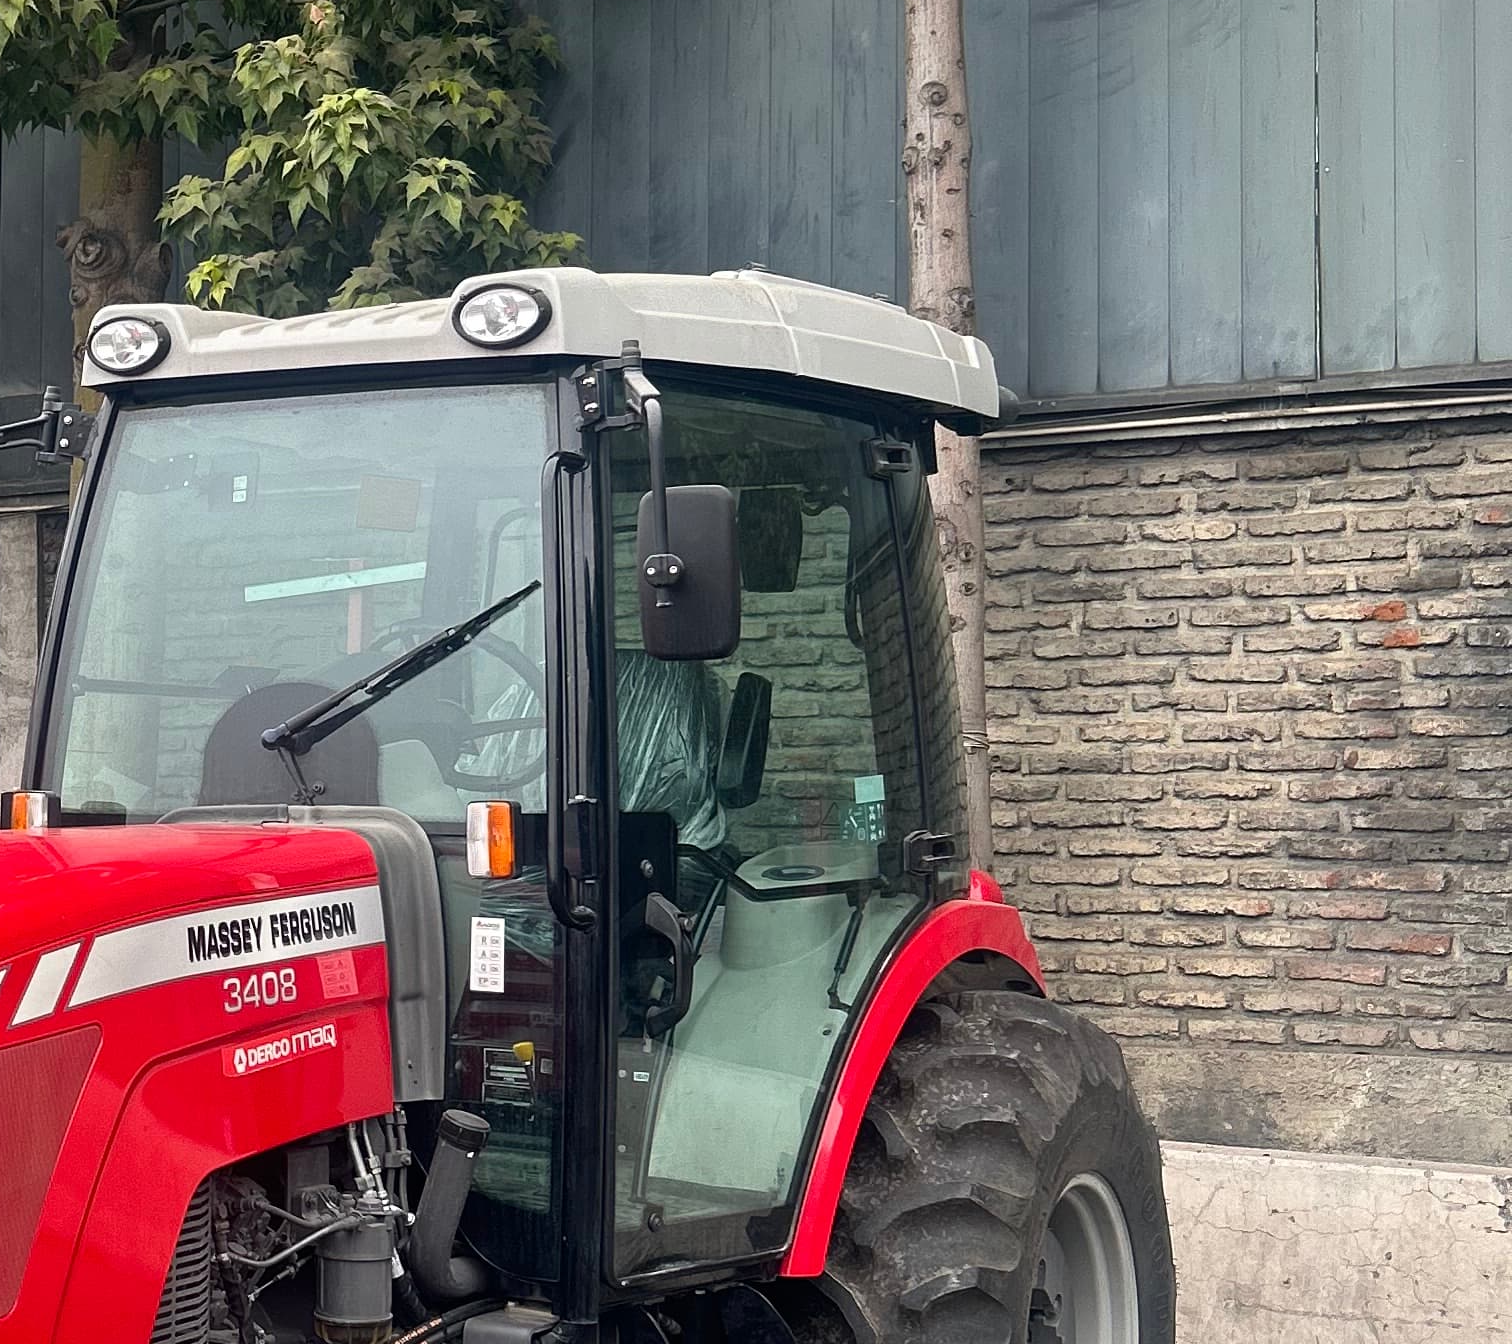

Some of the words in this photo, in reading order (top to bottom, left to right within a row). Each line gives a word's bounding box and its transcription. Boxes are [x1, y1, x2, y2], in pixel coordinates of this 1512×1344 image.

[188, 916, 262, 963] MASSEY
[270, 902, 357, 948] FERGUSON
[223, 968, 297, 1013] 3408
[248, 1038, 290, 1067] DERCO
